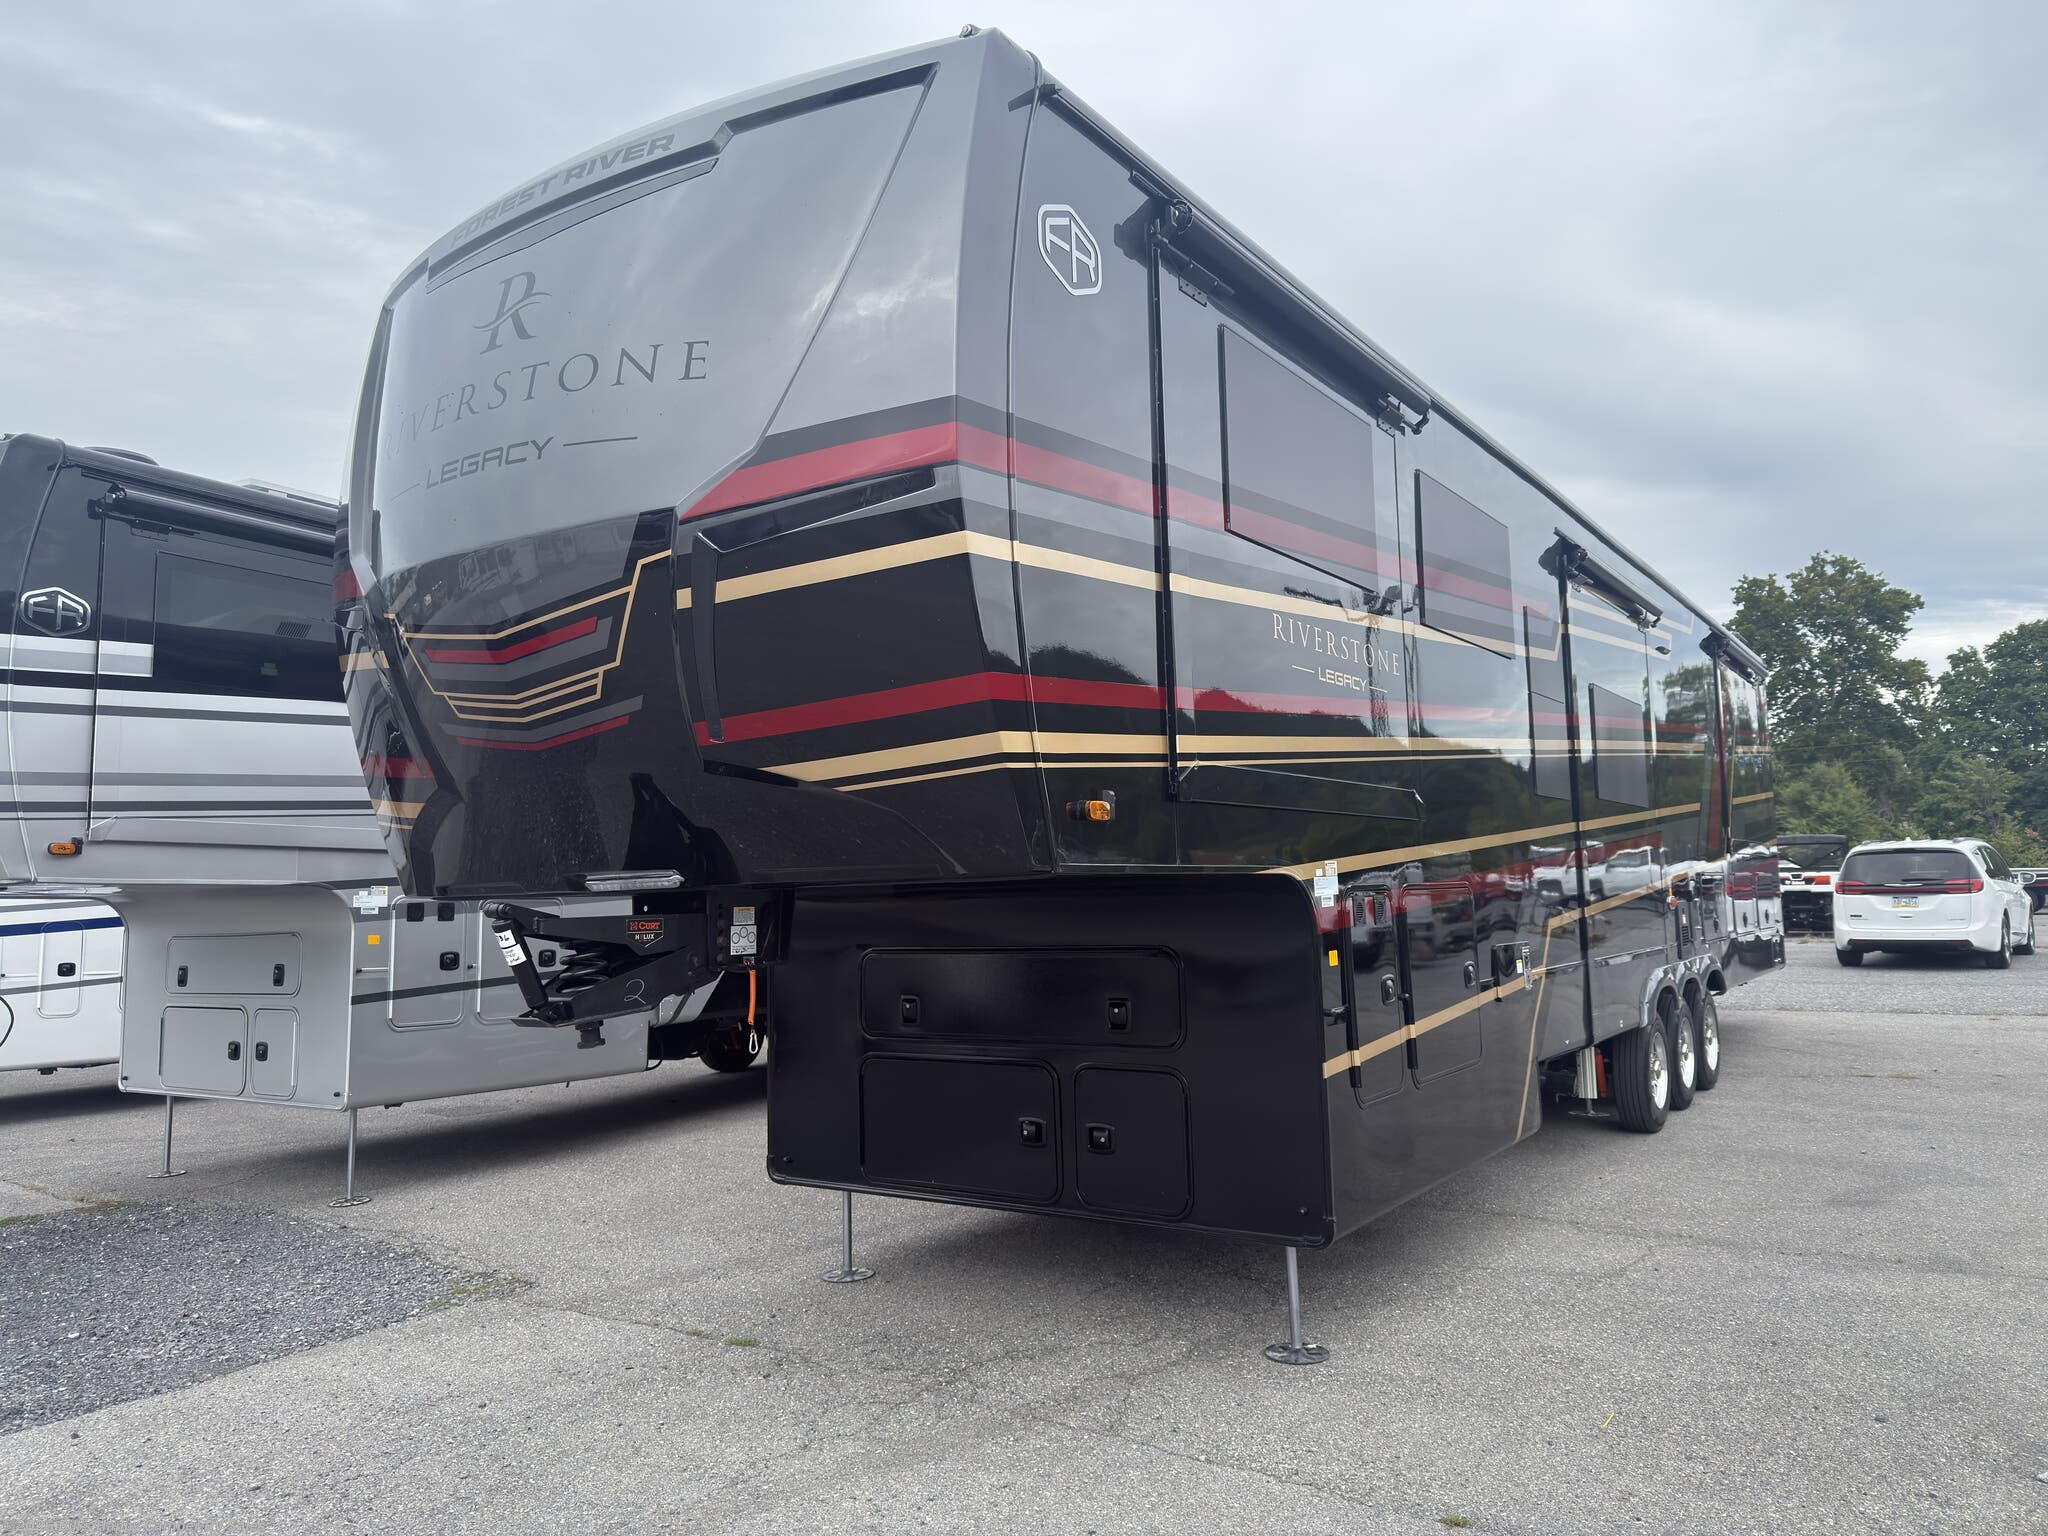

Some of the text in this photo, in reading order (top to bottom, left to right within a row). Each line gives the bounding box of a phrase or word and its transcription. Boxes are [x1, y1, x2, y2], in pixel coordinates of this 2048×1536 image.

[451, 134, 675, 248] FOREST RIVER
[426, 436, 554, 489] LEGACY
[1272, 612, 1400, 676] RIVERSTONE
[1318, 667, 1367, 692] LEGACY
[624, 978, 646, 1004] 2
